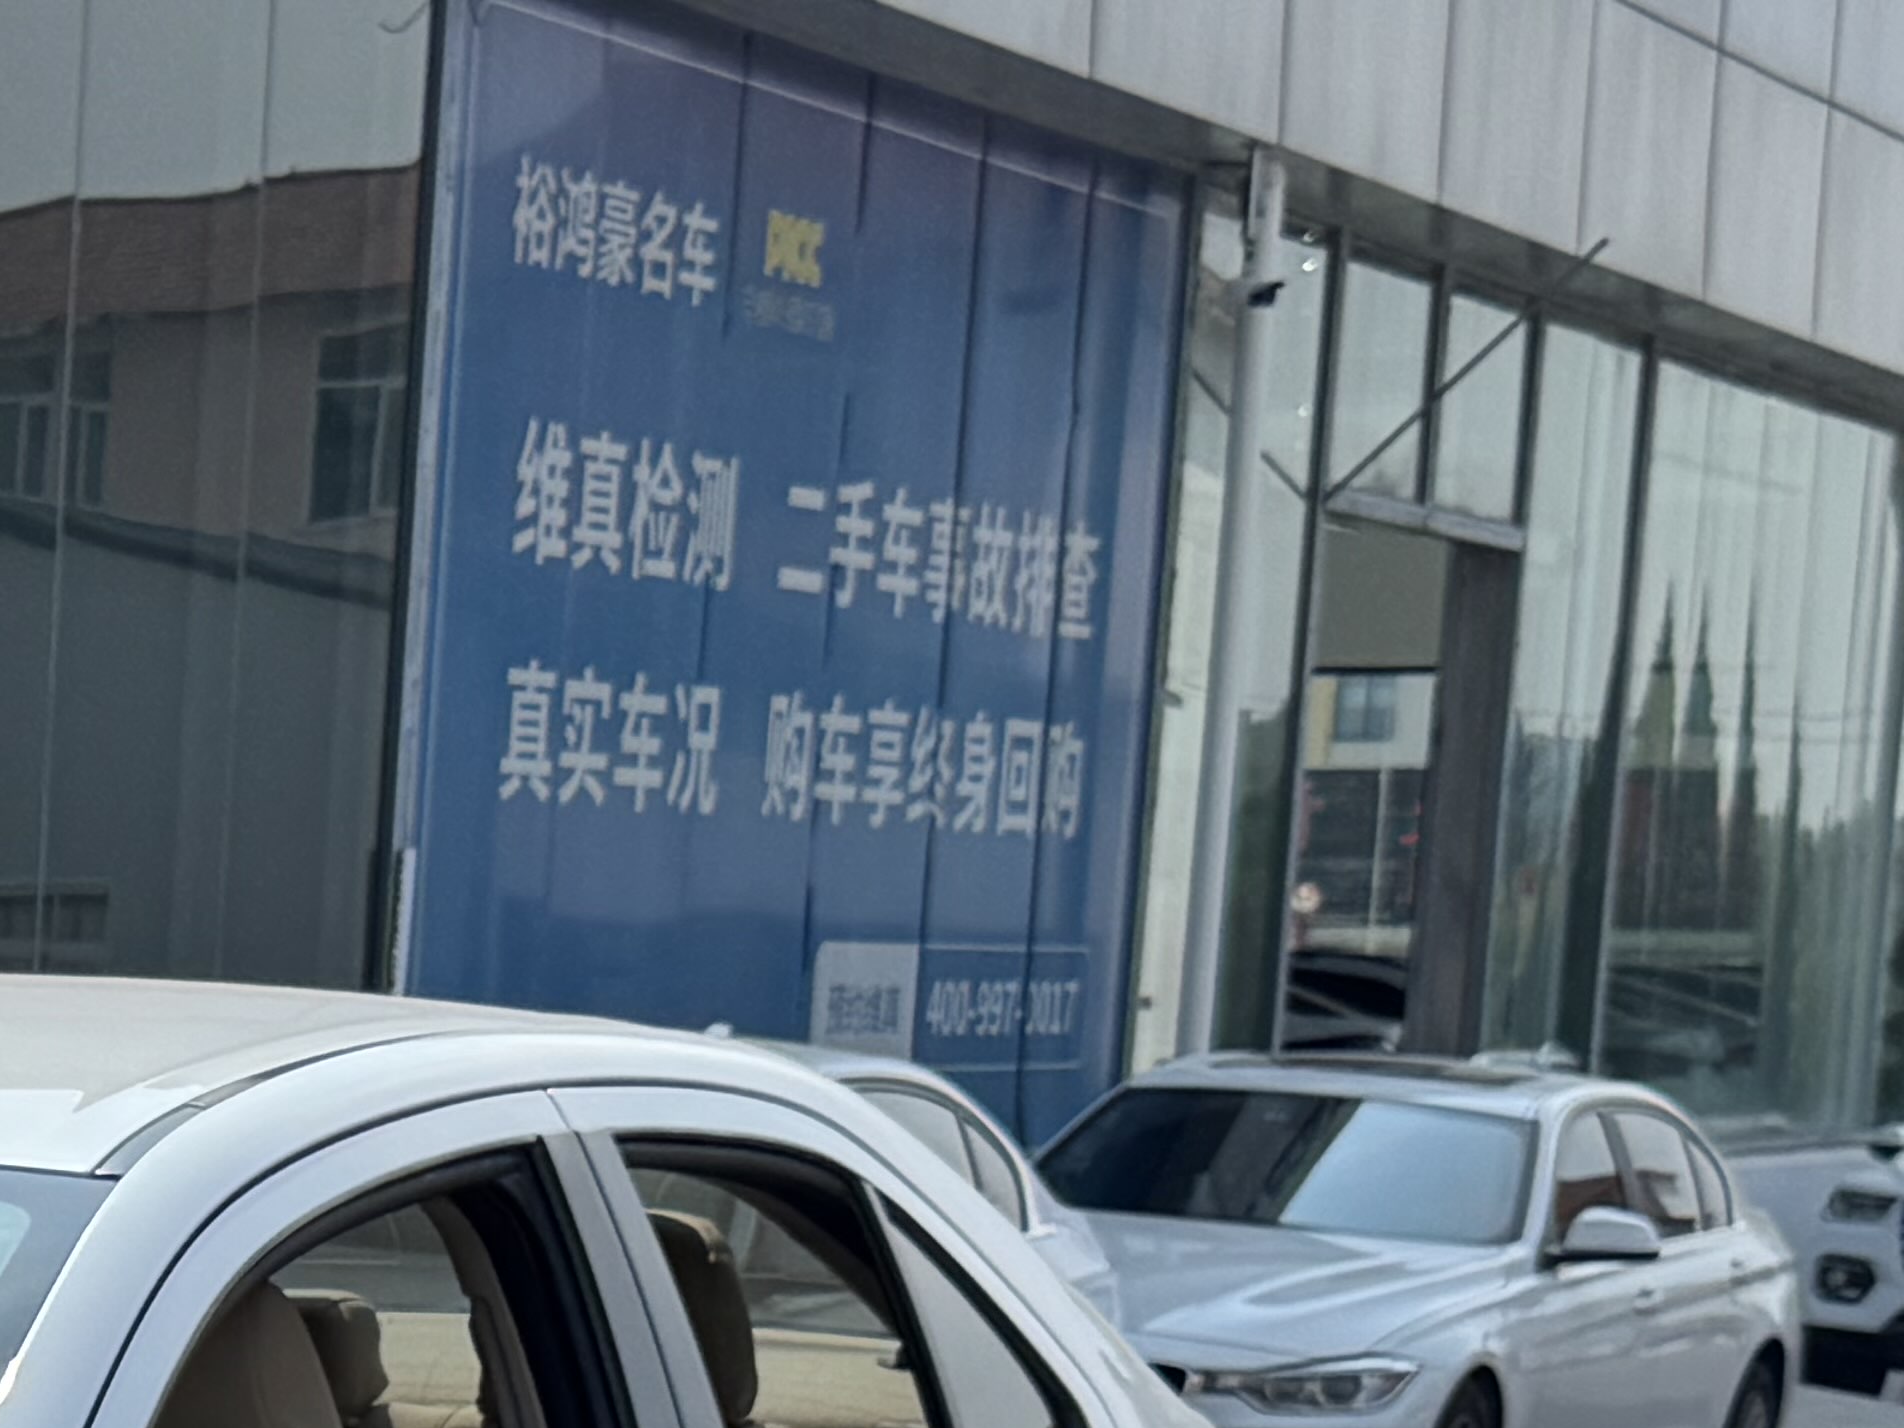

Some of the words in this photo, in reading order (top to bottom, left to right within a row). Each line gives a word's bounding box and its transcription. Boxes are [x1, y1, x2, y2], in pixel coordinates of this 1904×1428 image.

[513, 154, 719, 307] 裕鸿豪名车
[512, 417, 739, 591] 维真检测
[777, 481, 1101, 639] 二手车事故排查
[498, 660, 720, 815] 真实车况
[760, 690, 1086, 841] 购车享终身回购
